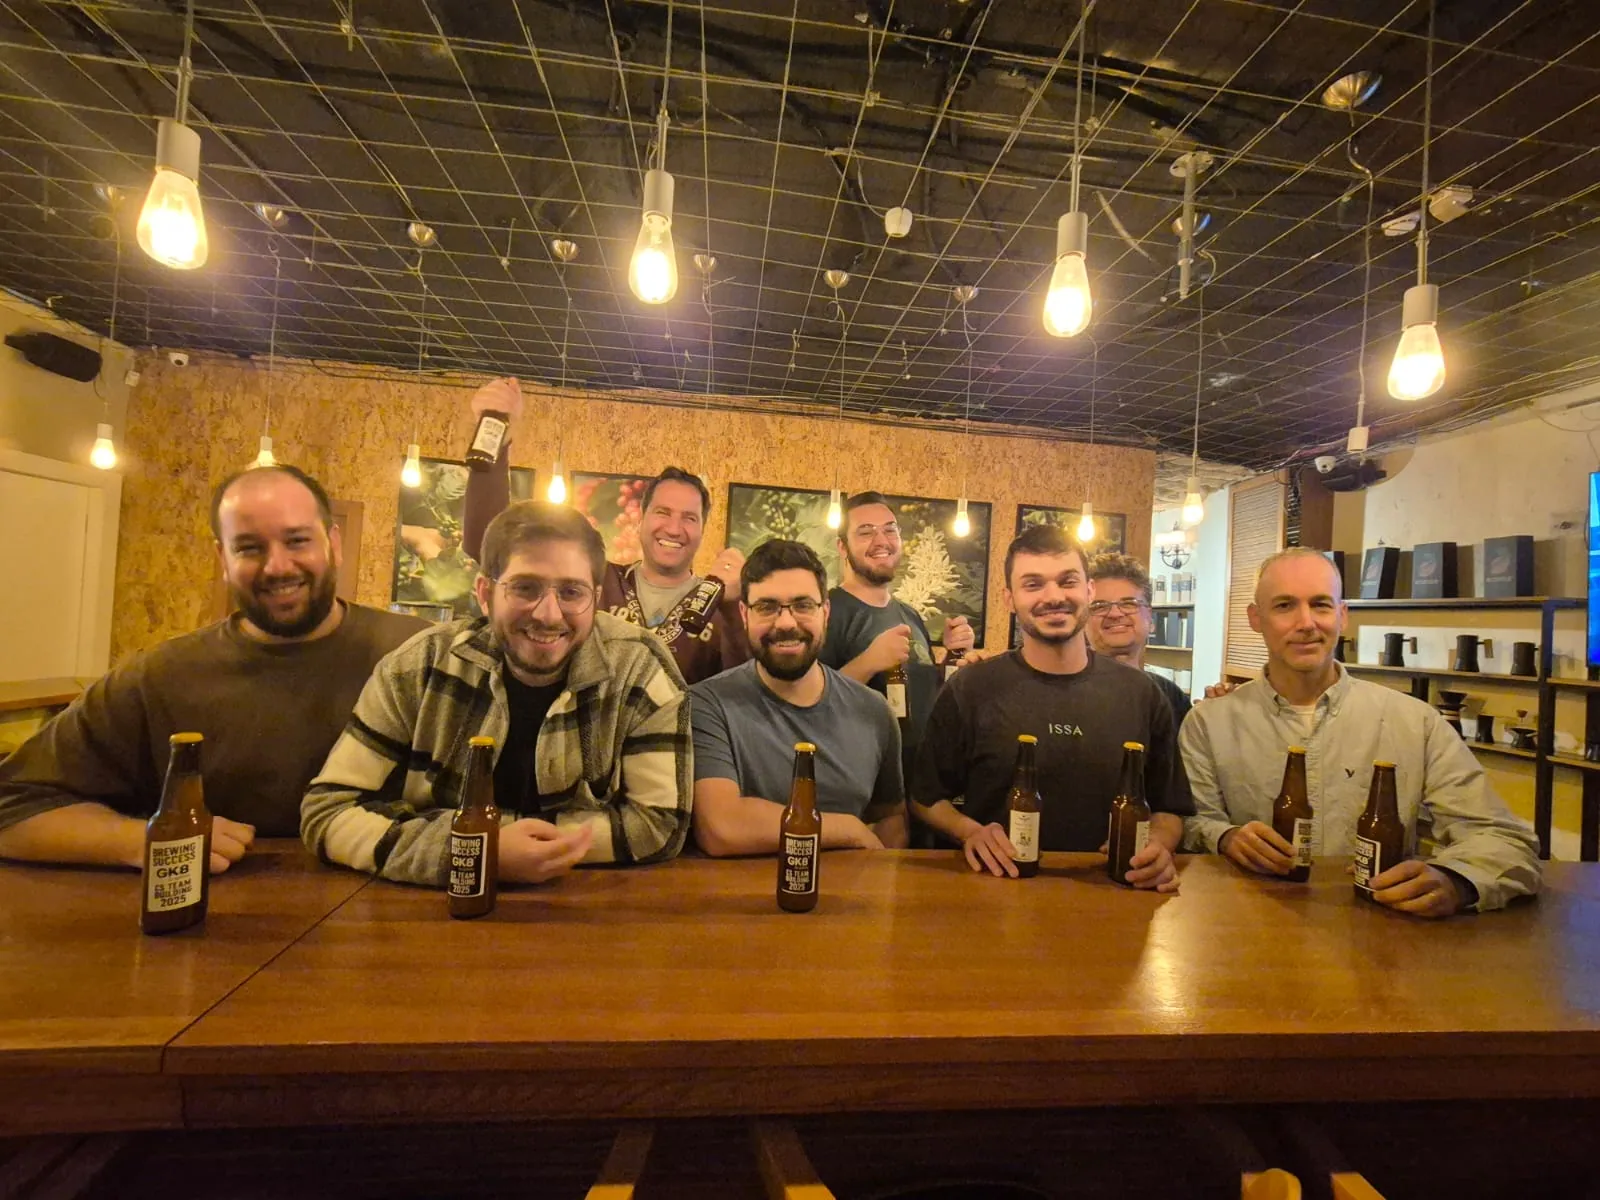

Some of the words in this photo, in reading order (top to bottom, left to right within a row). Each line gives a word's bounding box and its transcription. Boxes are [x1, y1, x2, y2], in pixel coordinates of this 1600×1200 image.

[1049, 723, 1083, 736] ISSA
[153, 842, 196, 857] BREWING
[153, 852, 195, 866] SUCCESS
[157, 864, 189, 878] GK8
[168, 879, 191, 890] TEAM
[154, 887, 192, 899] BUILDING
[161, 895, 186, 907] 2025
